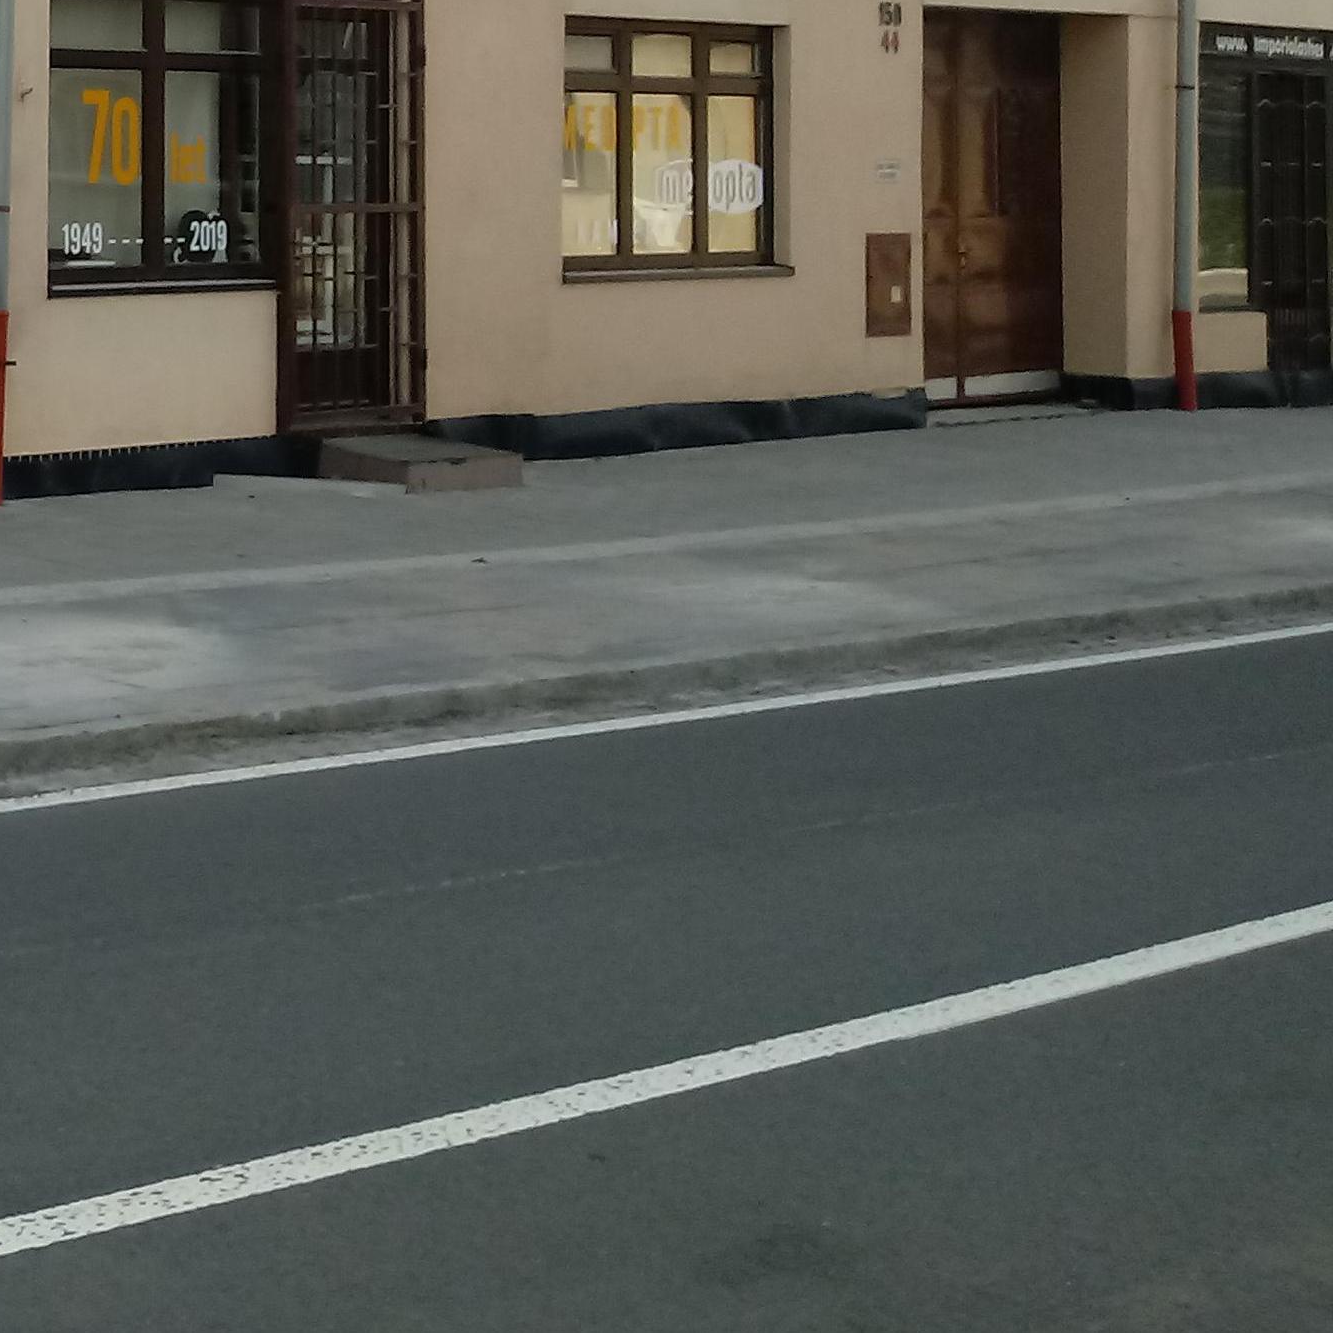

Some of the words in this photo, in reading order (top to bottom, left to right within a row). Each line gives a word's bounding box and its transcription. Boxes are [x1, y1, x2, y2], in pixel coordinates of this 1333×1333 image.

[81, 88, 142, 186] 70
[61, 222, 103, 255] 1949
[189, 219, 228, 252] 2019
